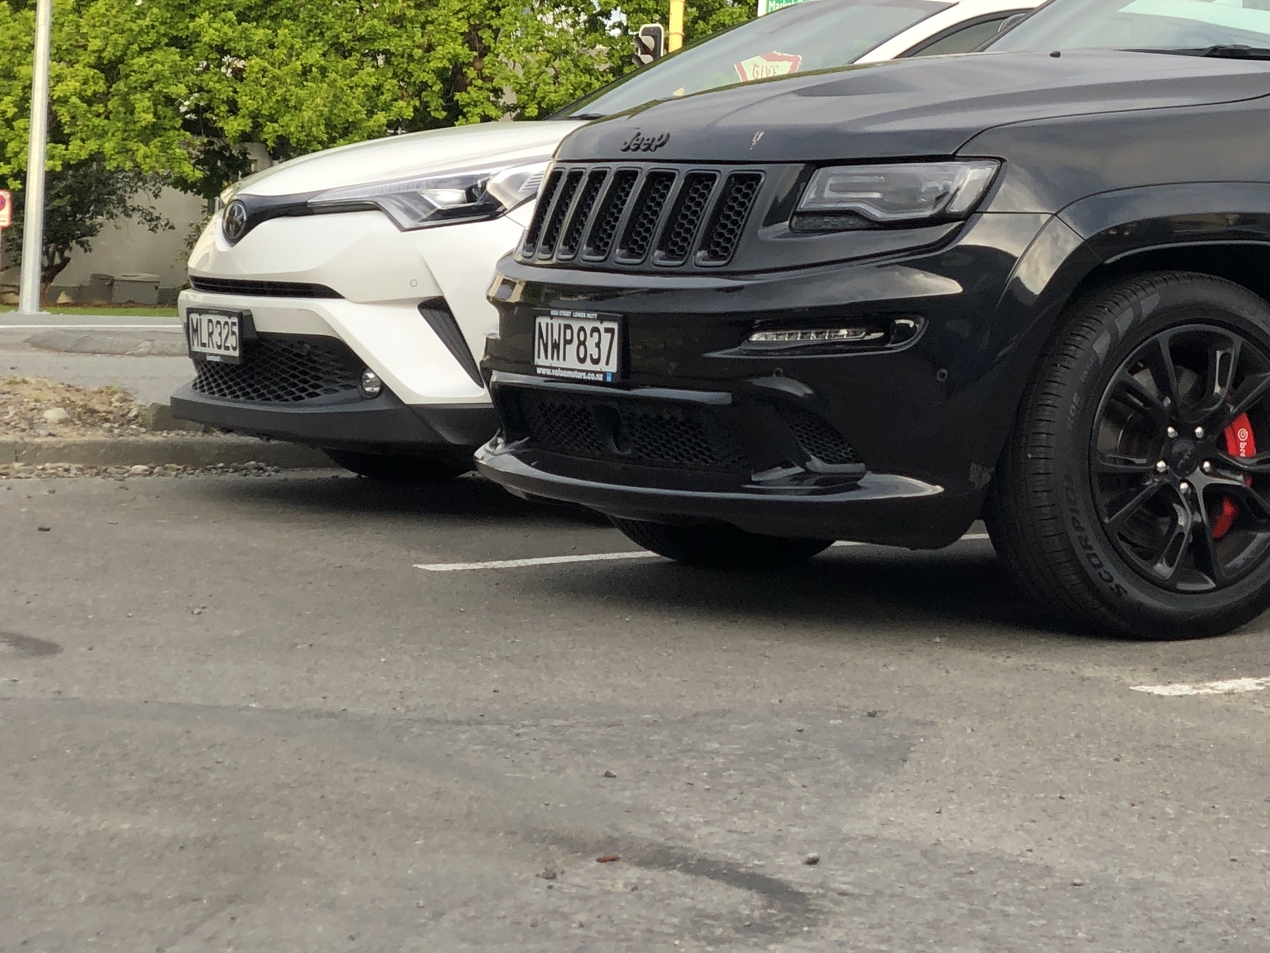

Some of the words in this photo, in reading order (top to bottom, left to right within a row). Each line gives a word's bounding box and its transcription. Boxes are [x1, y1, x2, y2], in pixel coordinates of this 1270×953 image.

[620, 132, 671, 153] Jeep
[190, 317, 238, 352] MLR325
[537, 321, 616, 366] NWP837
[1239, 441, 1248, 457] bre
